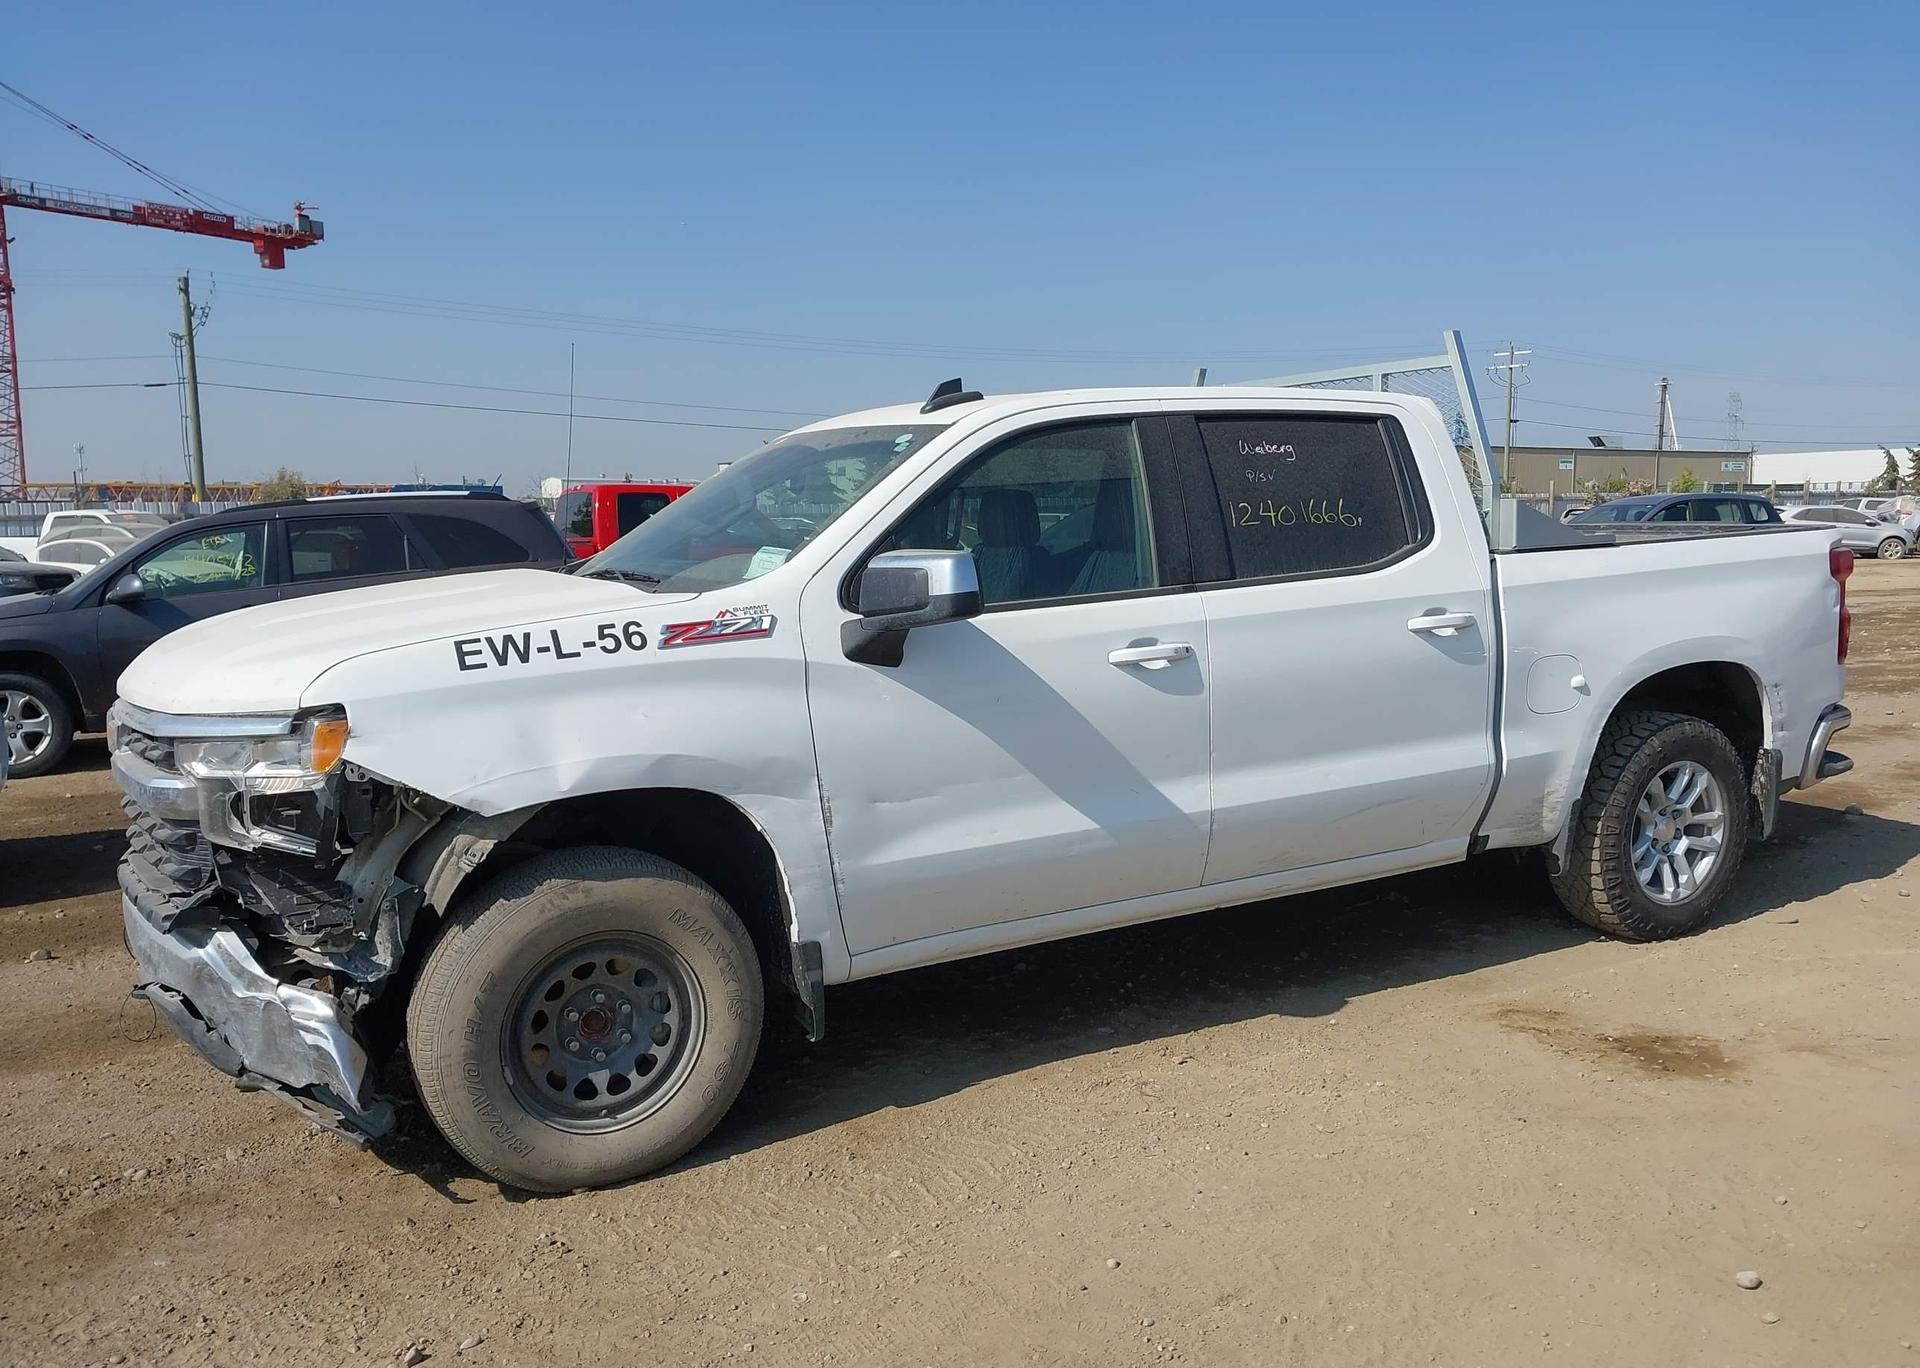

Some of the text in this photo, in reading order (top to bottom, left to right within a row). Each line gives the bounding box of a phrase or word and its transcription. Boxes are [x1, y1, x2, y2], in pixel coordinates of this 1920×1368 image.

[657, 614, 777, 650] Z71
[733, 604, 769, 612] SUMMIT
[453, 621, 648, 671] EW-L-56
[666, 907, 745, 1021] MAXXIS
[462, 1062, 536, 1159] BRAVO
